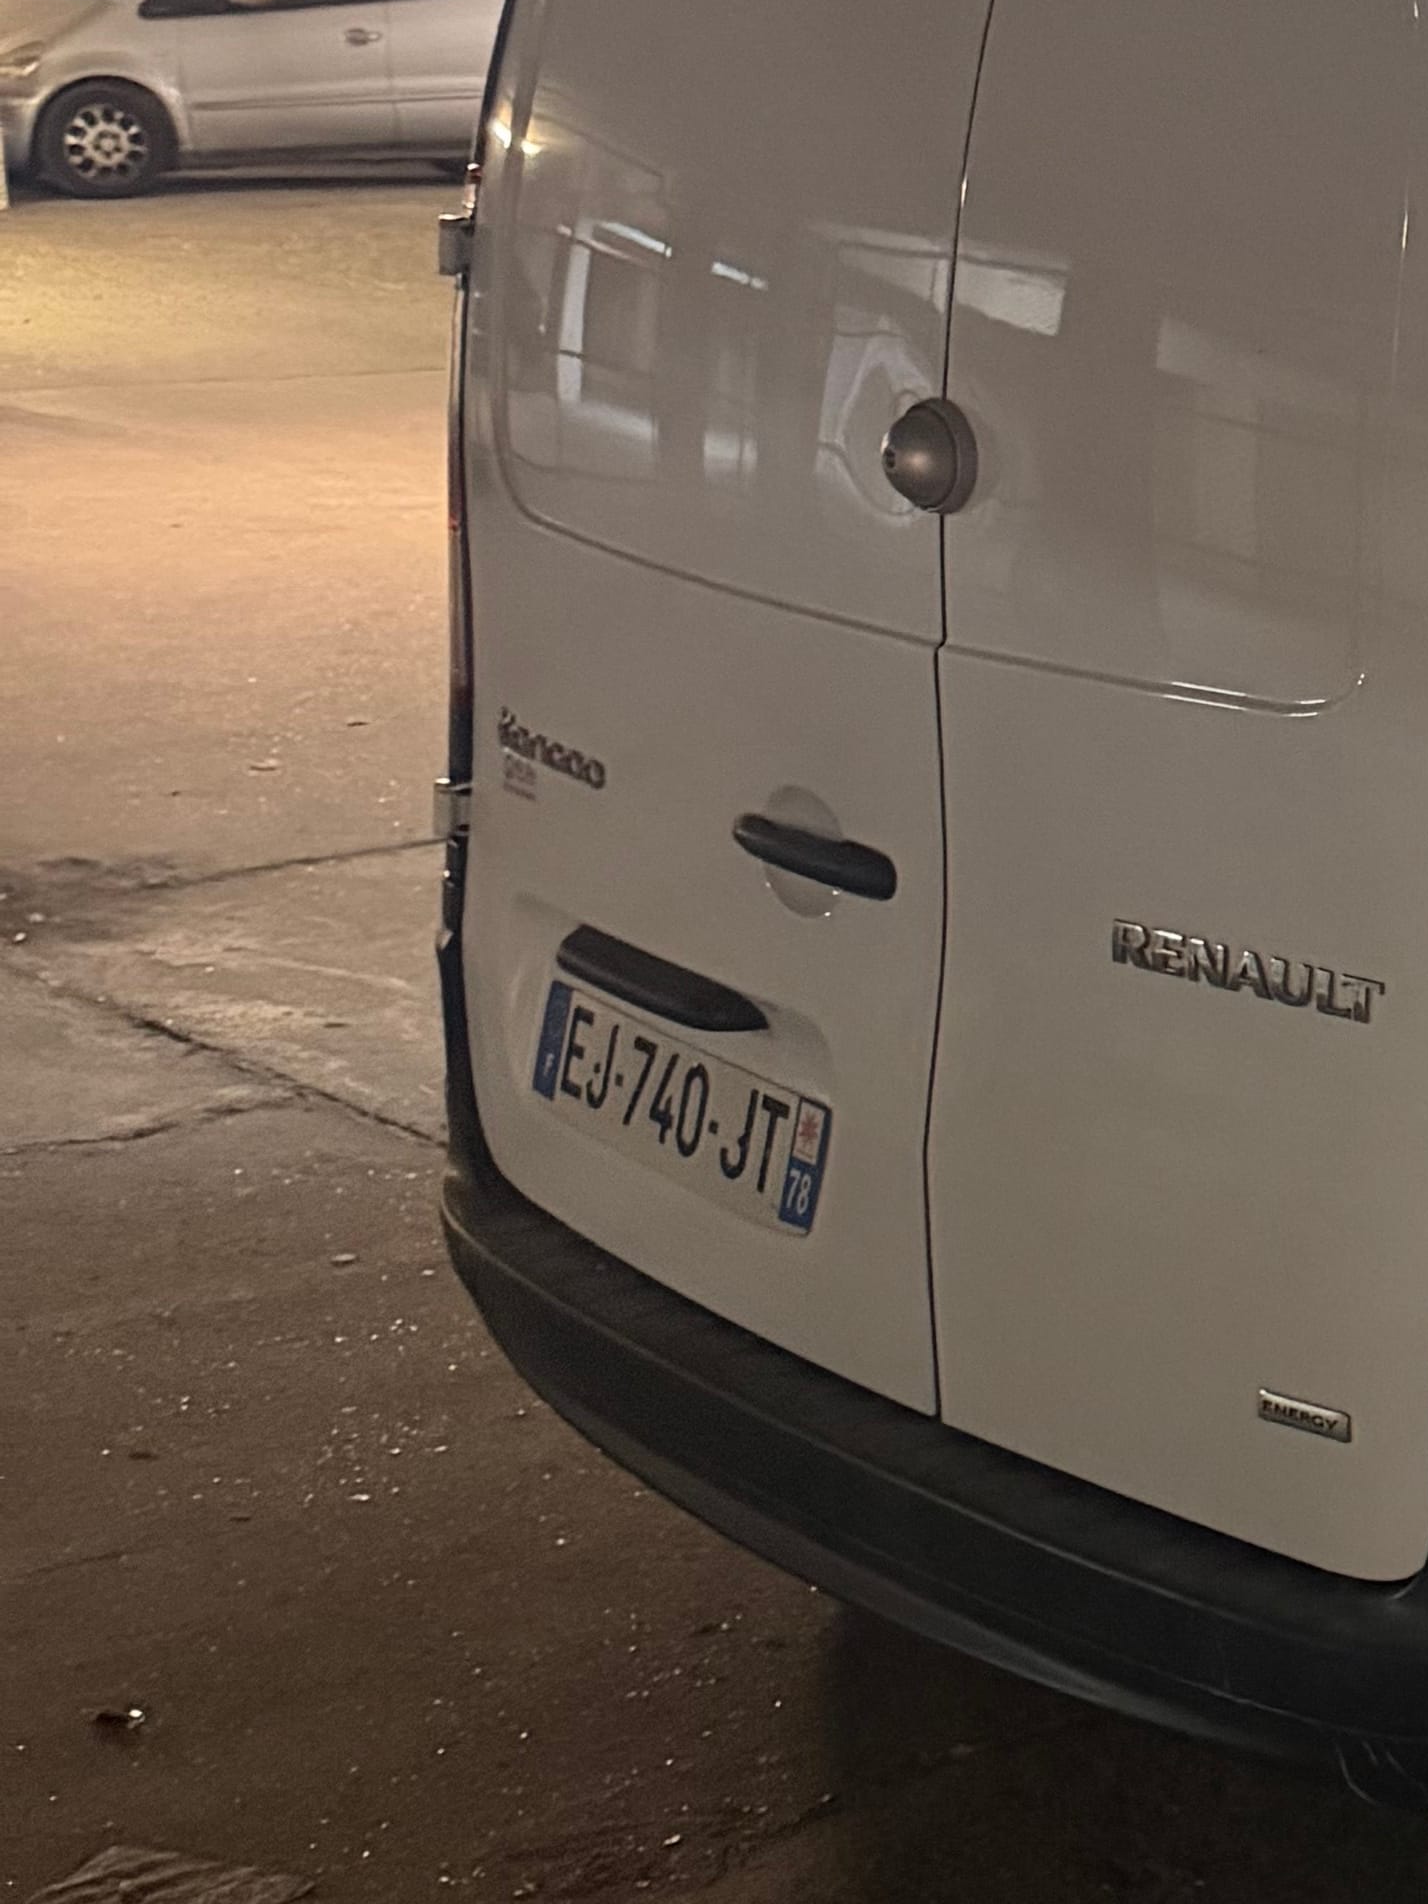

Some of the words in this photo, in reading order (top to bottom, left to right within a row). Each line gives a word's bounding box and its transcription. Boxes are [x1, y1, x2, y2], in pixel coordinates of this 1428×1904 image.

[1111, 917, 1386, 1024] RENAULT
[785, 1169, 812, 1215] 78
[1262, 1399, 1339, 1430] ENERGY
